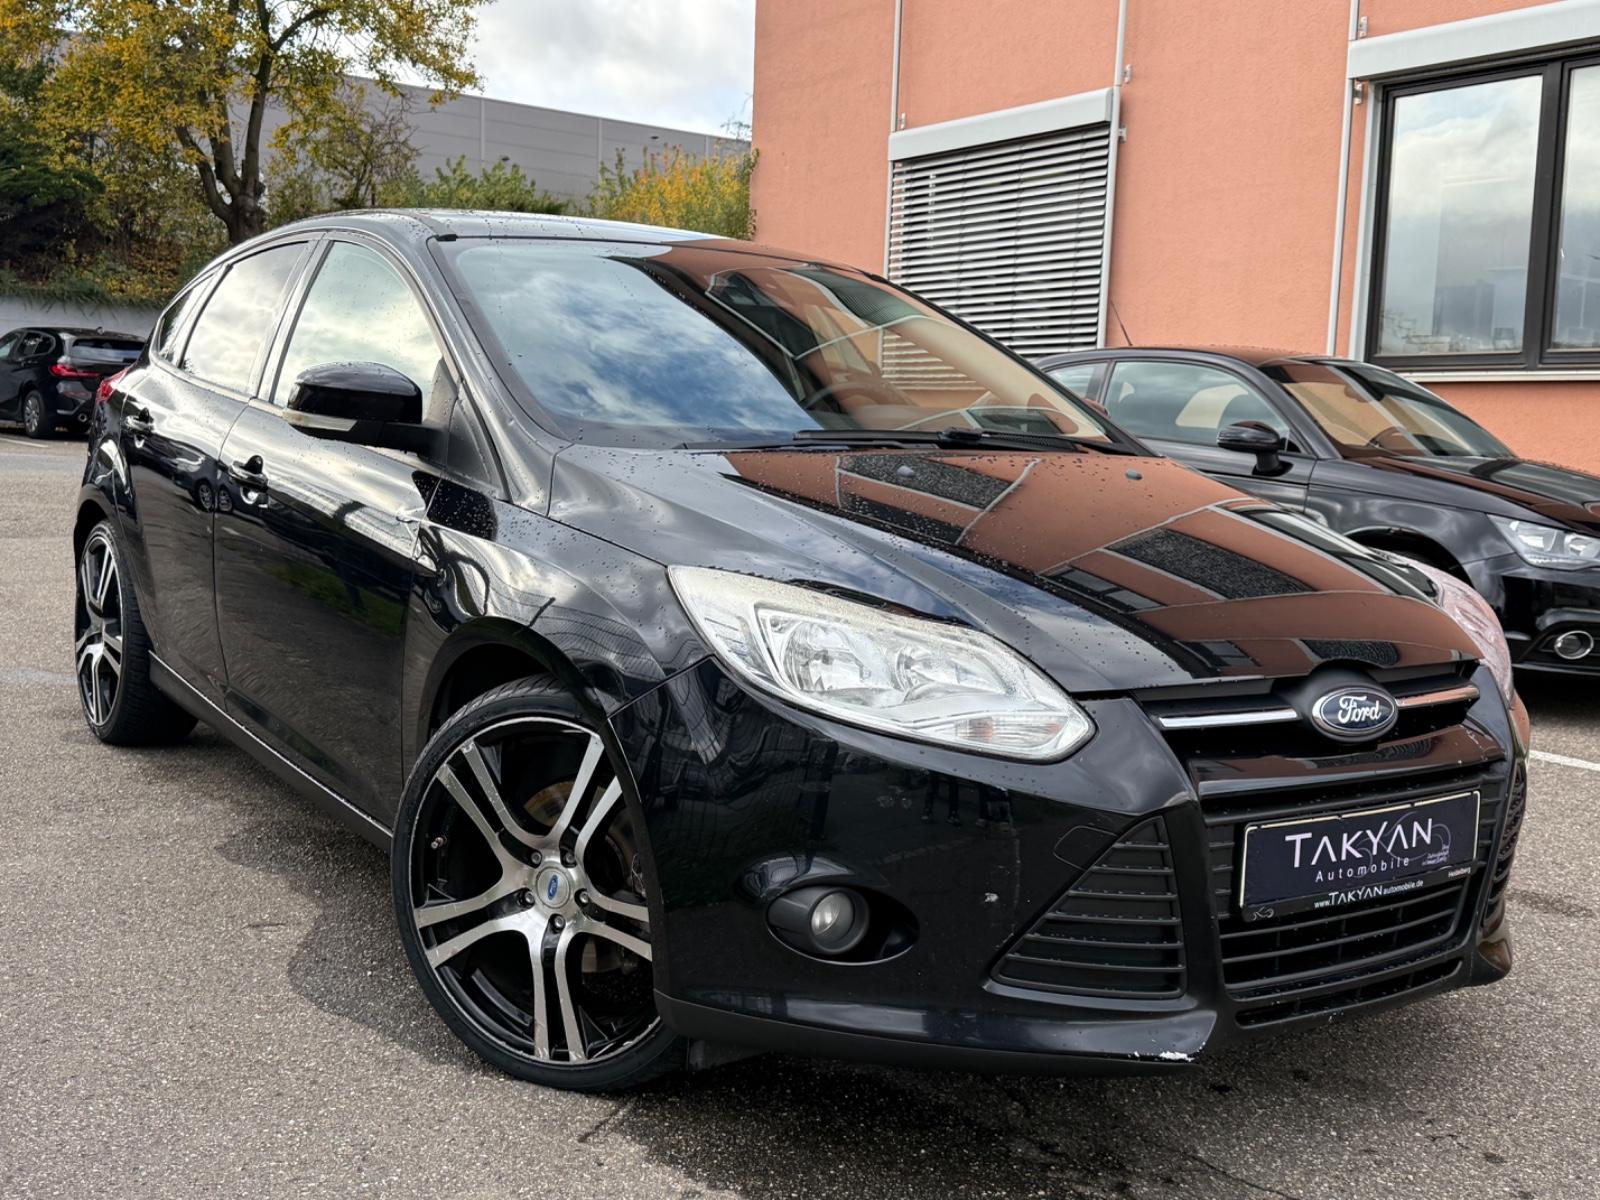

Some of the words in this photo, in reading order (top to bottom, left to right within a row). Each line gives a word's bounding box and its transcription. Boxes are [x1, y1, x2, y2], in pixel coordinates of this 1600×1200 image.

[1338, 695, 1381, 724] Ford
[1285, 818, 1433, 868] TAKYAN
[1315, 856, 1410, 883] Automobile
